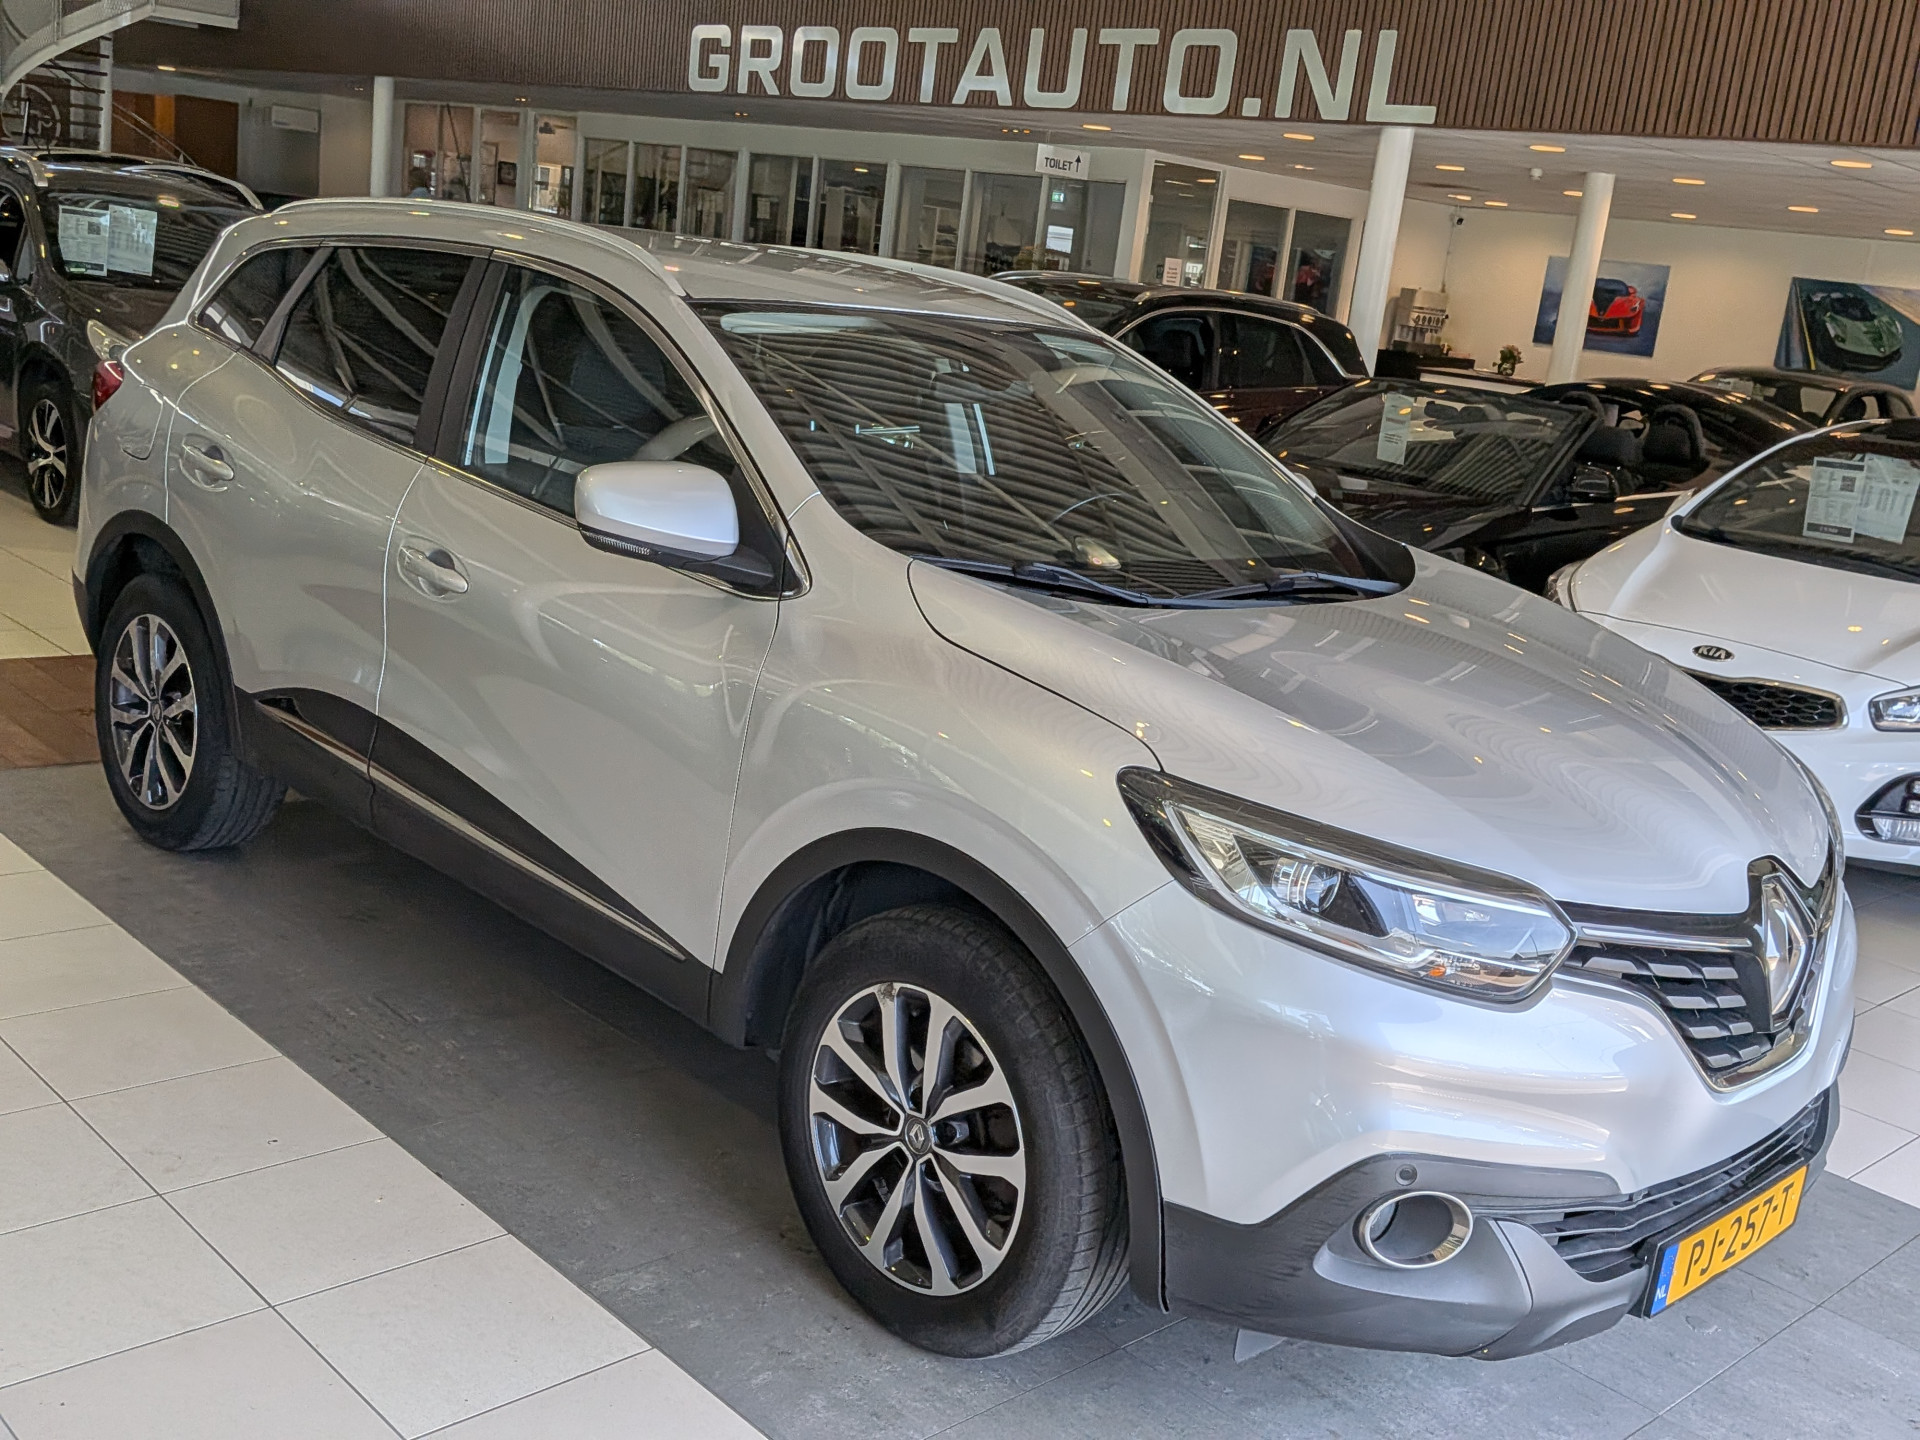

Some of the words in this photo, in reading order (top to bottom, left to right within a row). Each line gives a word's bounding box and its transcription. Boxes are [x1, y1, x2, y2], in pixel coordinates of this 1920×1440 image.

[688, 24, 1437, 124] GROOTAUTO.NL
[1044, 156, 1073, 171] TOILET
[1697, 645, 1726, 660] KIA
[1684, 1182, 1795, 1288] PJ-257-T
[1655, 1284, 1667, 1301] NL
